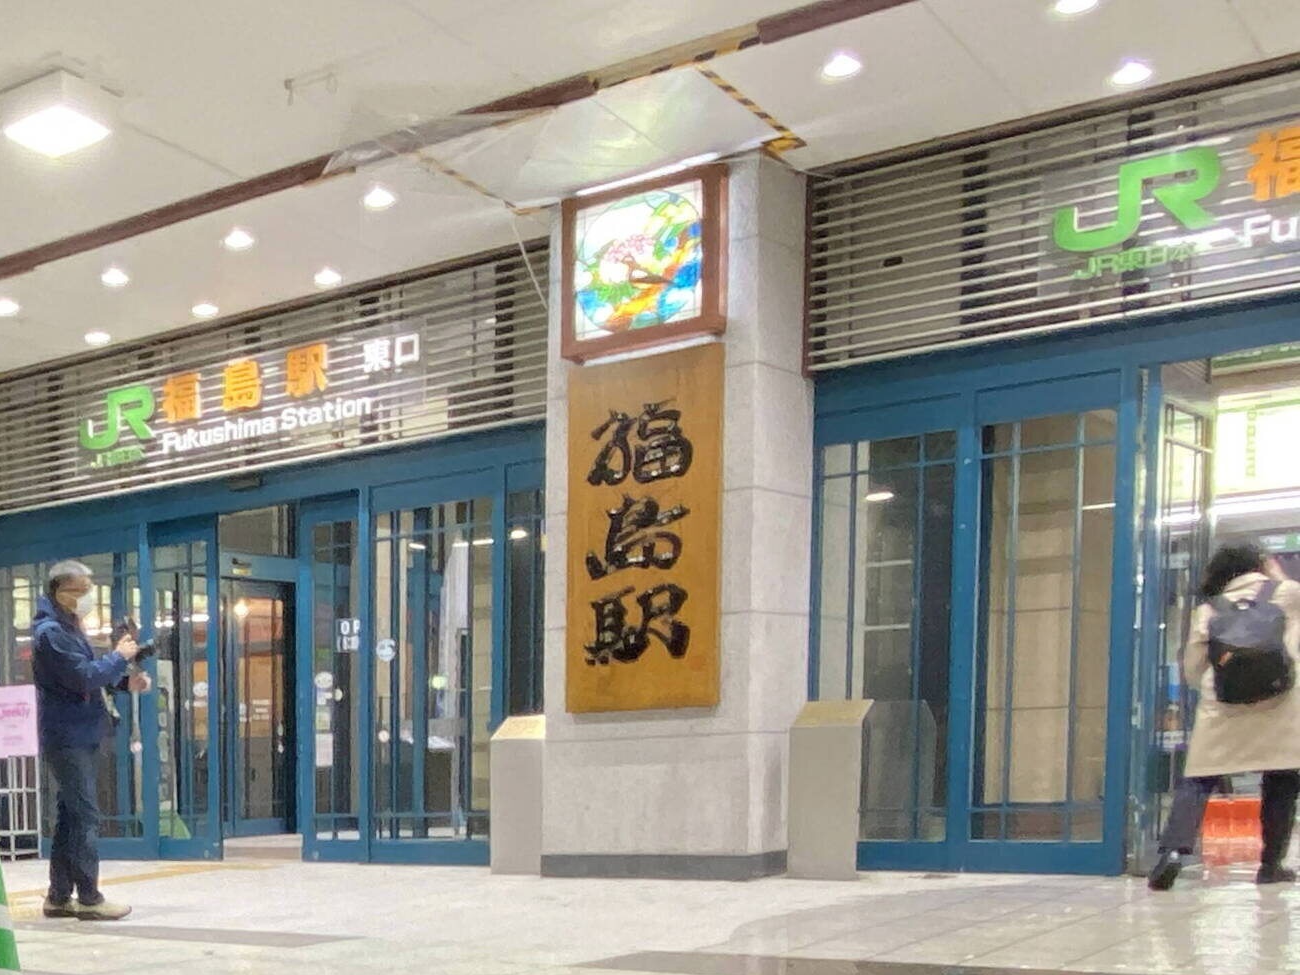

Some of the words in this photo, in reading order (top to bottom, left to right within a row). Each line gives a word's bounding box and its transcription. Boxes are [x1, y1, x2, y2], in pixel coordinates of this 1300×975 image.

[1054, 147, 1221, 251] JR
[80, 384, 155, 449] JR
[363, 333, 420, 373] 東口
[161, 417, 278, 452] Fukushima
[280, 396, 372, 431] Station
